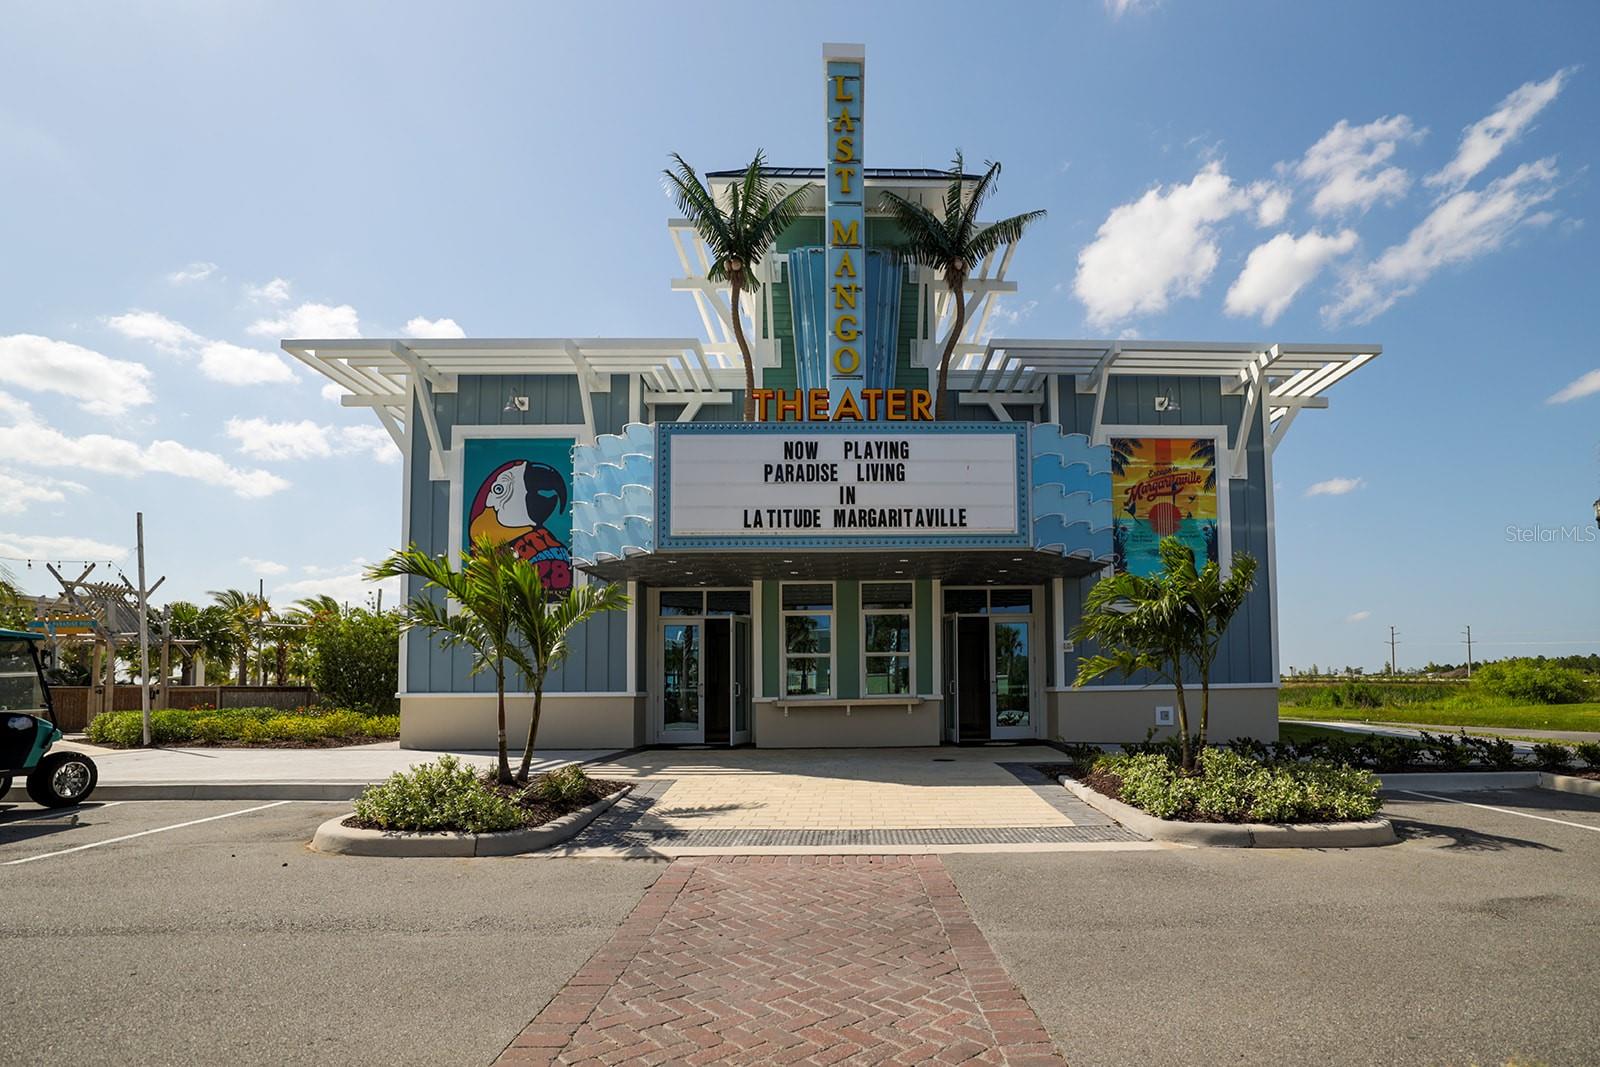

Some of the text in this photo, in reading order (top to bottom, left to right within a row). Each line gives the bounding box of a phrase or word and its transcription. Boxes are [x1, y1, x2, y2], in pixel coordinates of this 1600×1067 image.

[831, 75, 861, 374] LAST MANGO
[752, 387, 935, 421] THEATER
[783, 441, 910, 460] NOW PLAYING
[764, 463, 906, 482] PARADISE LIVING
[839, 486, 856, 505] IN
[1123, 471, 1203, 507] Margaritaville
[743, 508, 967, 528] LATITUDE MARGARITAVILLE
